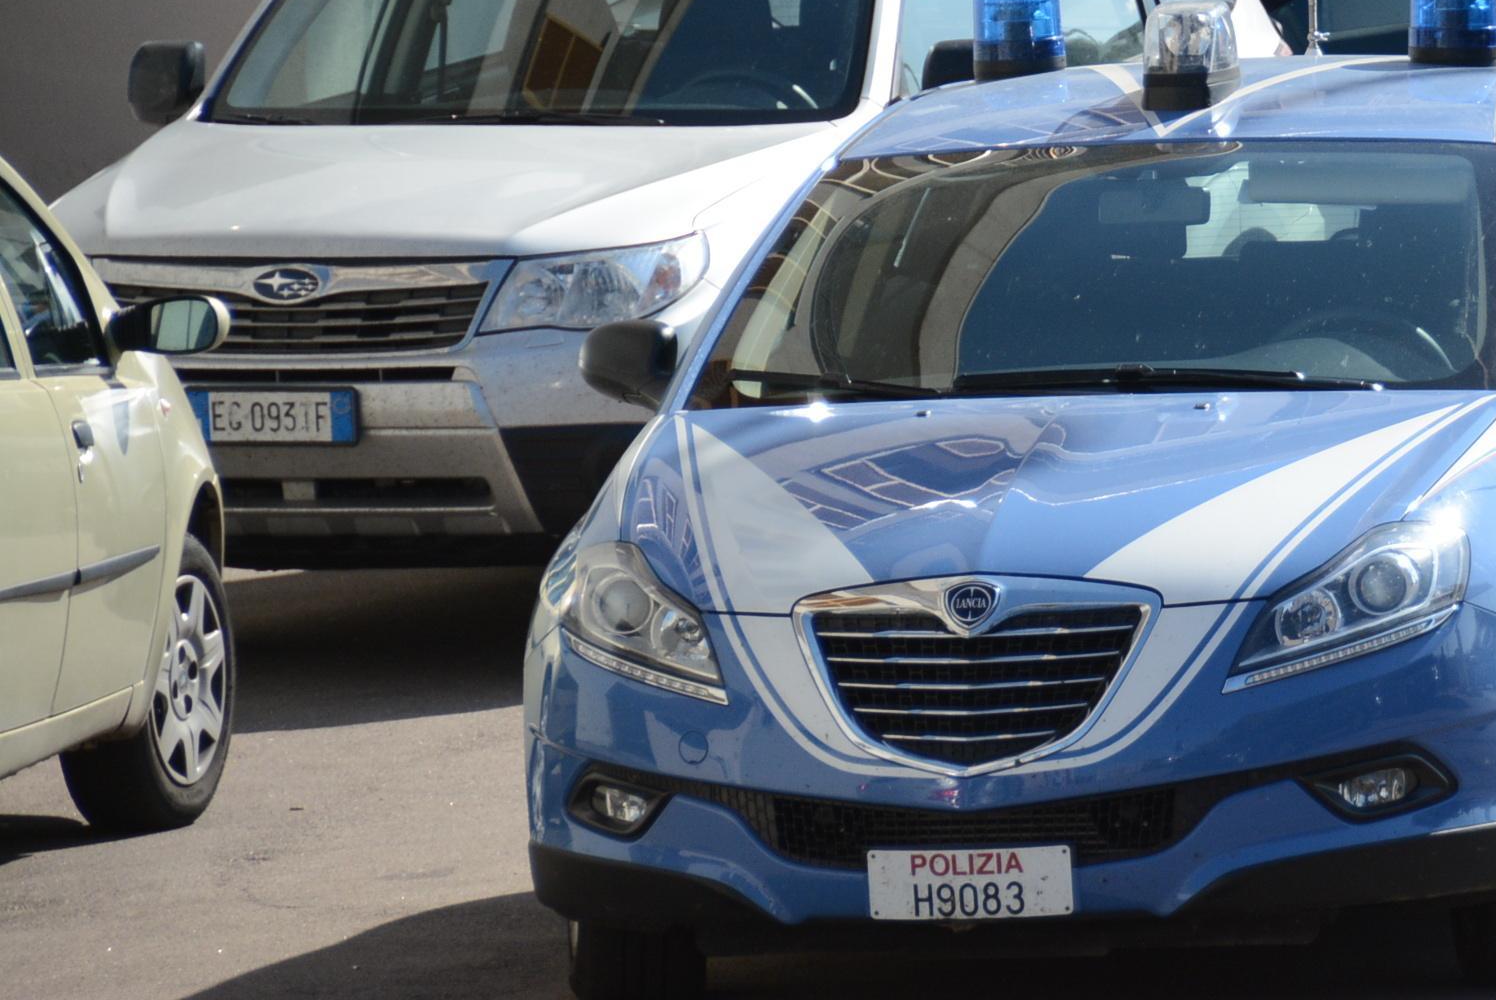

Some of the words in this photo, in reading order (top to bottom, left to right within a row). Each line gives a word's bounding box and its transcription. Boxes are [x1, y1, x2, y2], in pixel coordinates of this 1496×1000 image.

[956, 597, 987, 609] LANCIA
[909, 851, 1024, 877] POLIZIA
[913, 881, 1025, 917] H9083
